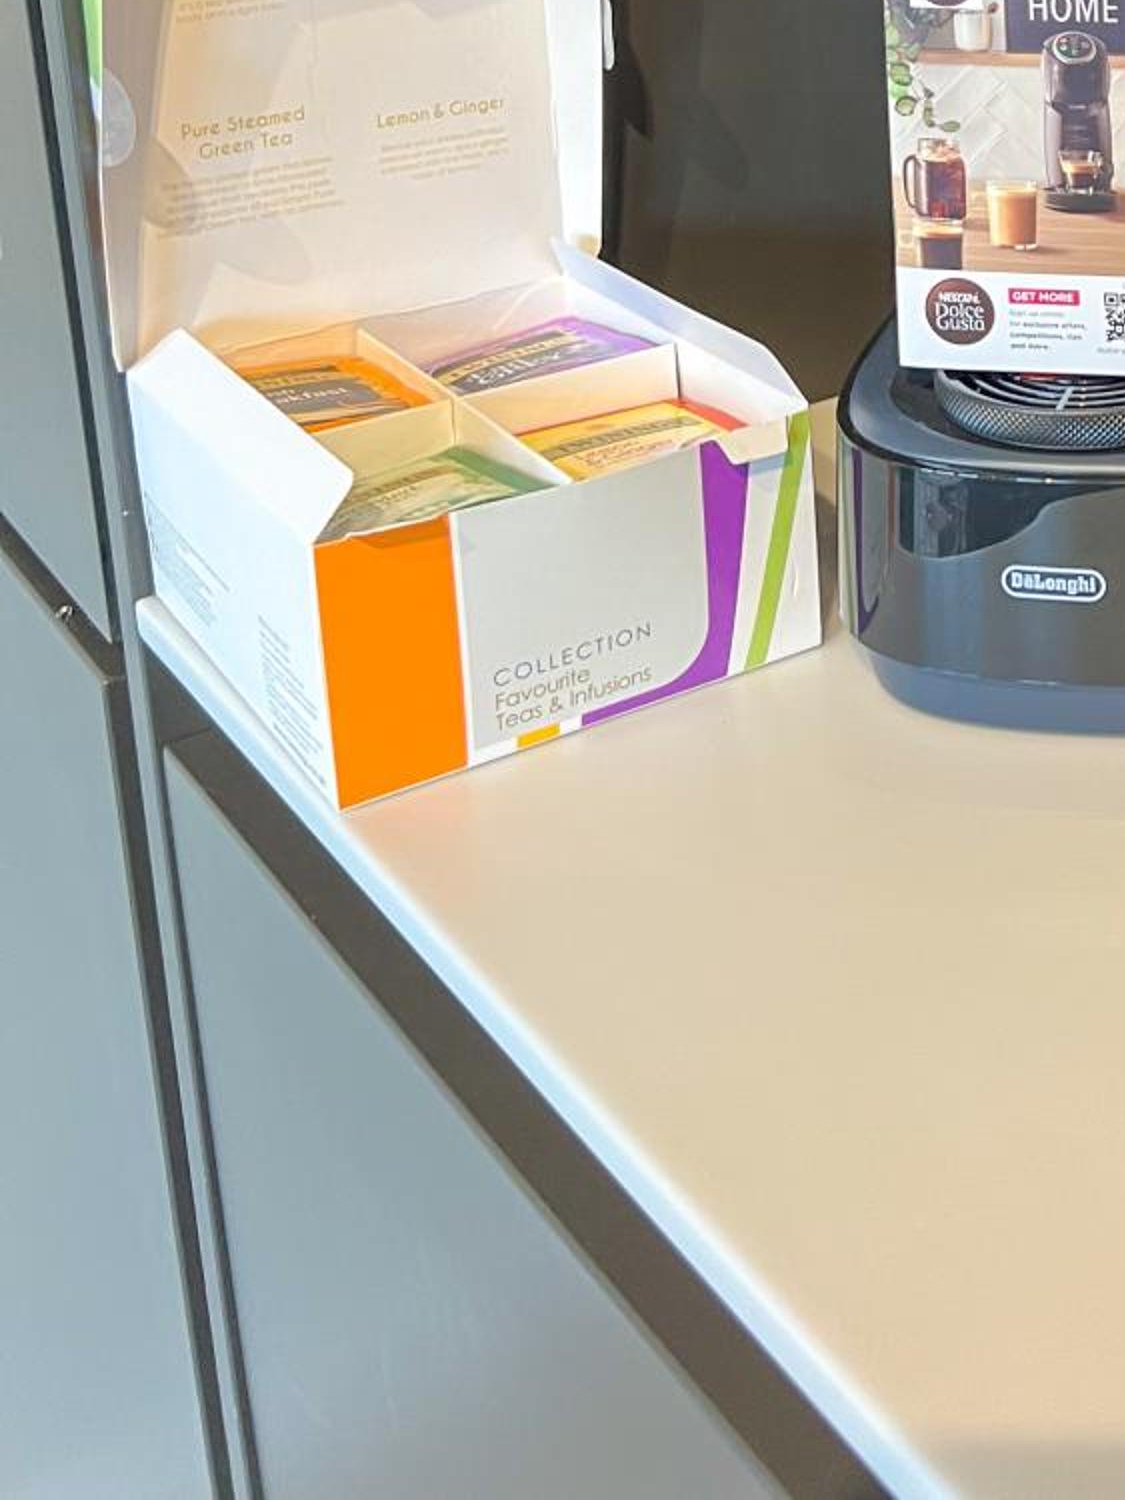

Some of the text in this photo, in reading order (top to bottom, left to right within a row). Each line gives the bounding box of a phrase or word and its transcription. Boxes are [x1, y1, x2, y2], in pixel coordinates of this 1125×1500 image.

[181, 105, 306, 140] Pure Steamed
[377, 98, 504, 129] Lemon & Ginger
[199, 131, 294, 160] Green Tea
[934, 301, 985, 319] Dolce
[1012, 291, 1074, 304] GET MORE
[935, 315, 985, 331] Gusto
[493, 623, 652, 687] COLLECTION
[495, 668, 591, 711] Favourite
[495, 666, 653, 731] Teas & Infusions
